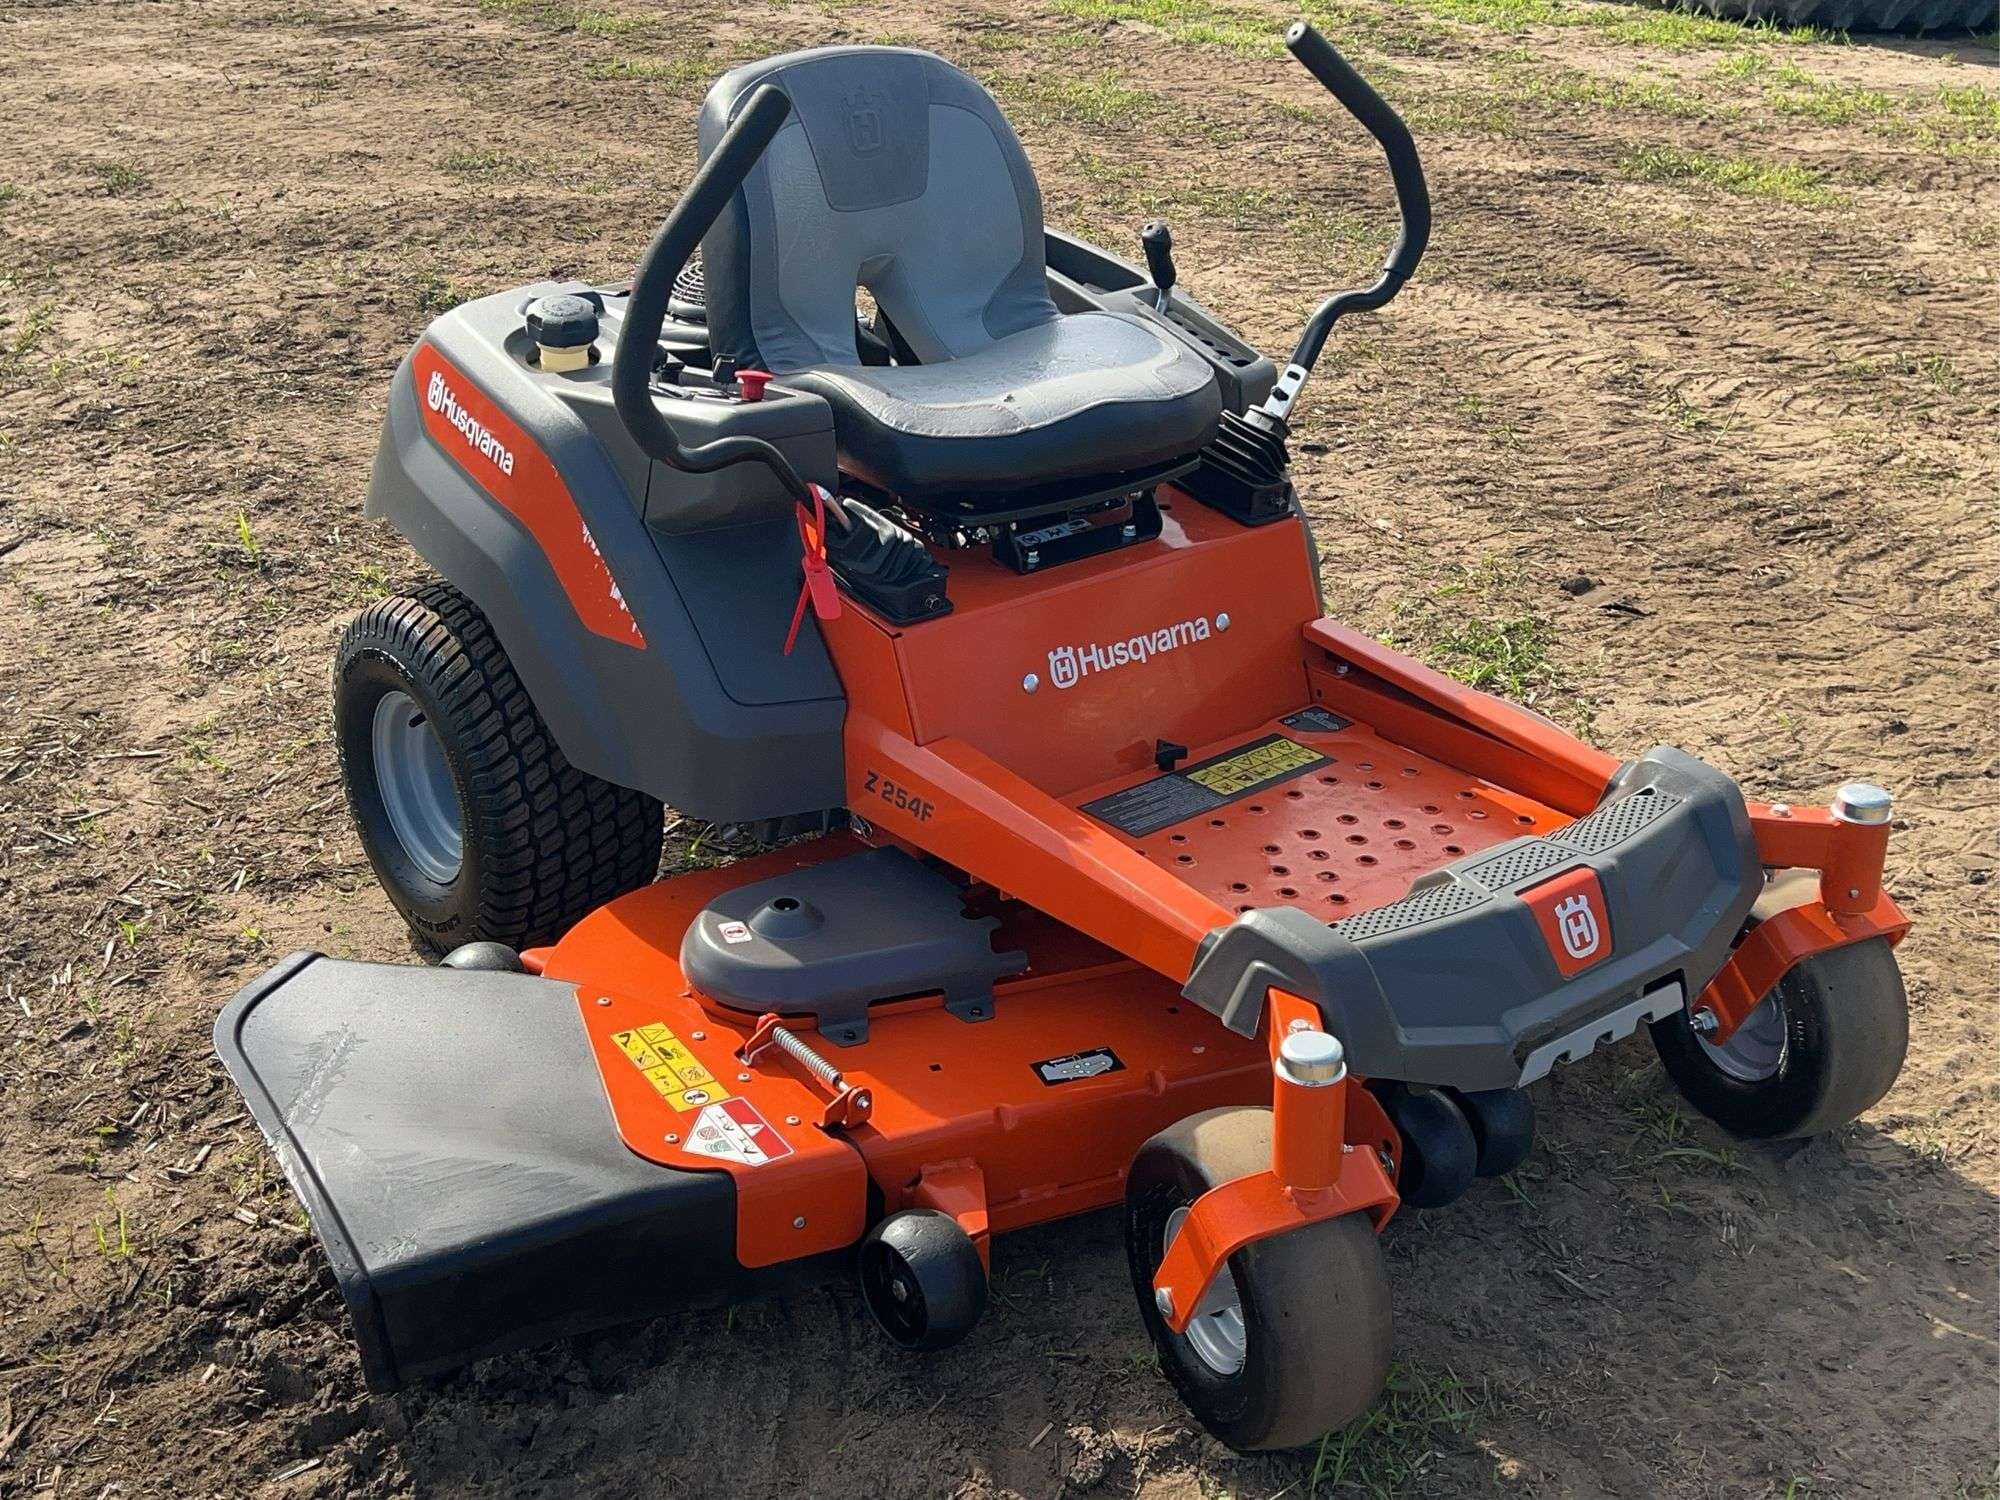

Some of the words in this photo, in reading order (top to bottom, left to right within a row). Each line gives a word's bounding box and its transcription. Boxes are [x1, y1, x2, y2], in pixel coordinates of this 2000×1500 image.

[441, 387, 514, 476] Husqvarna
[1078, 616, 1211, 676] Husqvarna
[864, 770, 879, 793] Z
[881, 781, 934, 821] 254F
